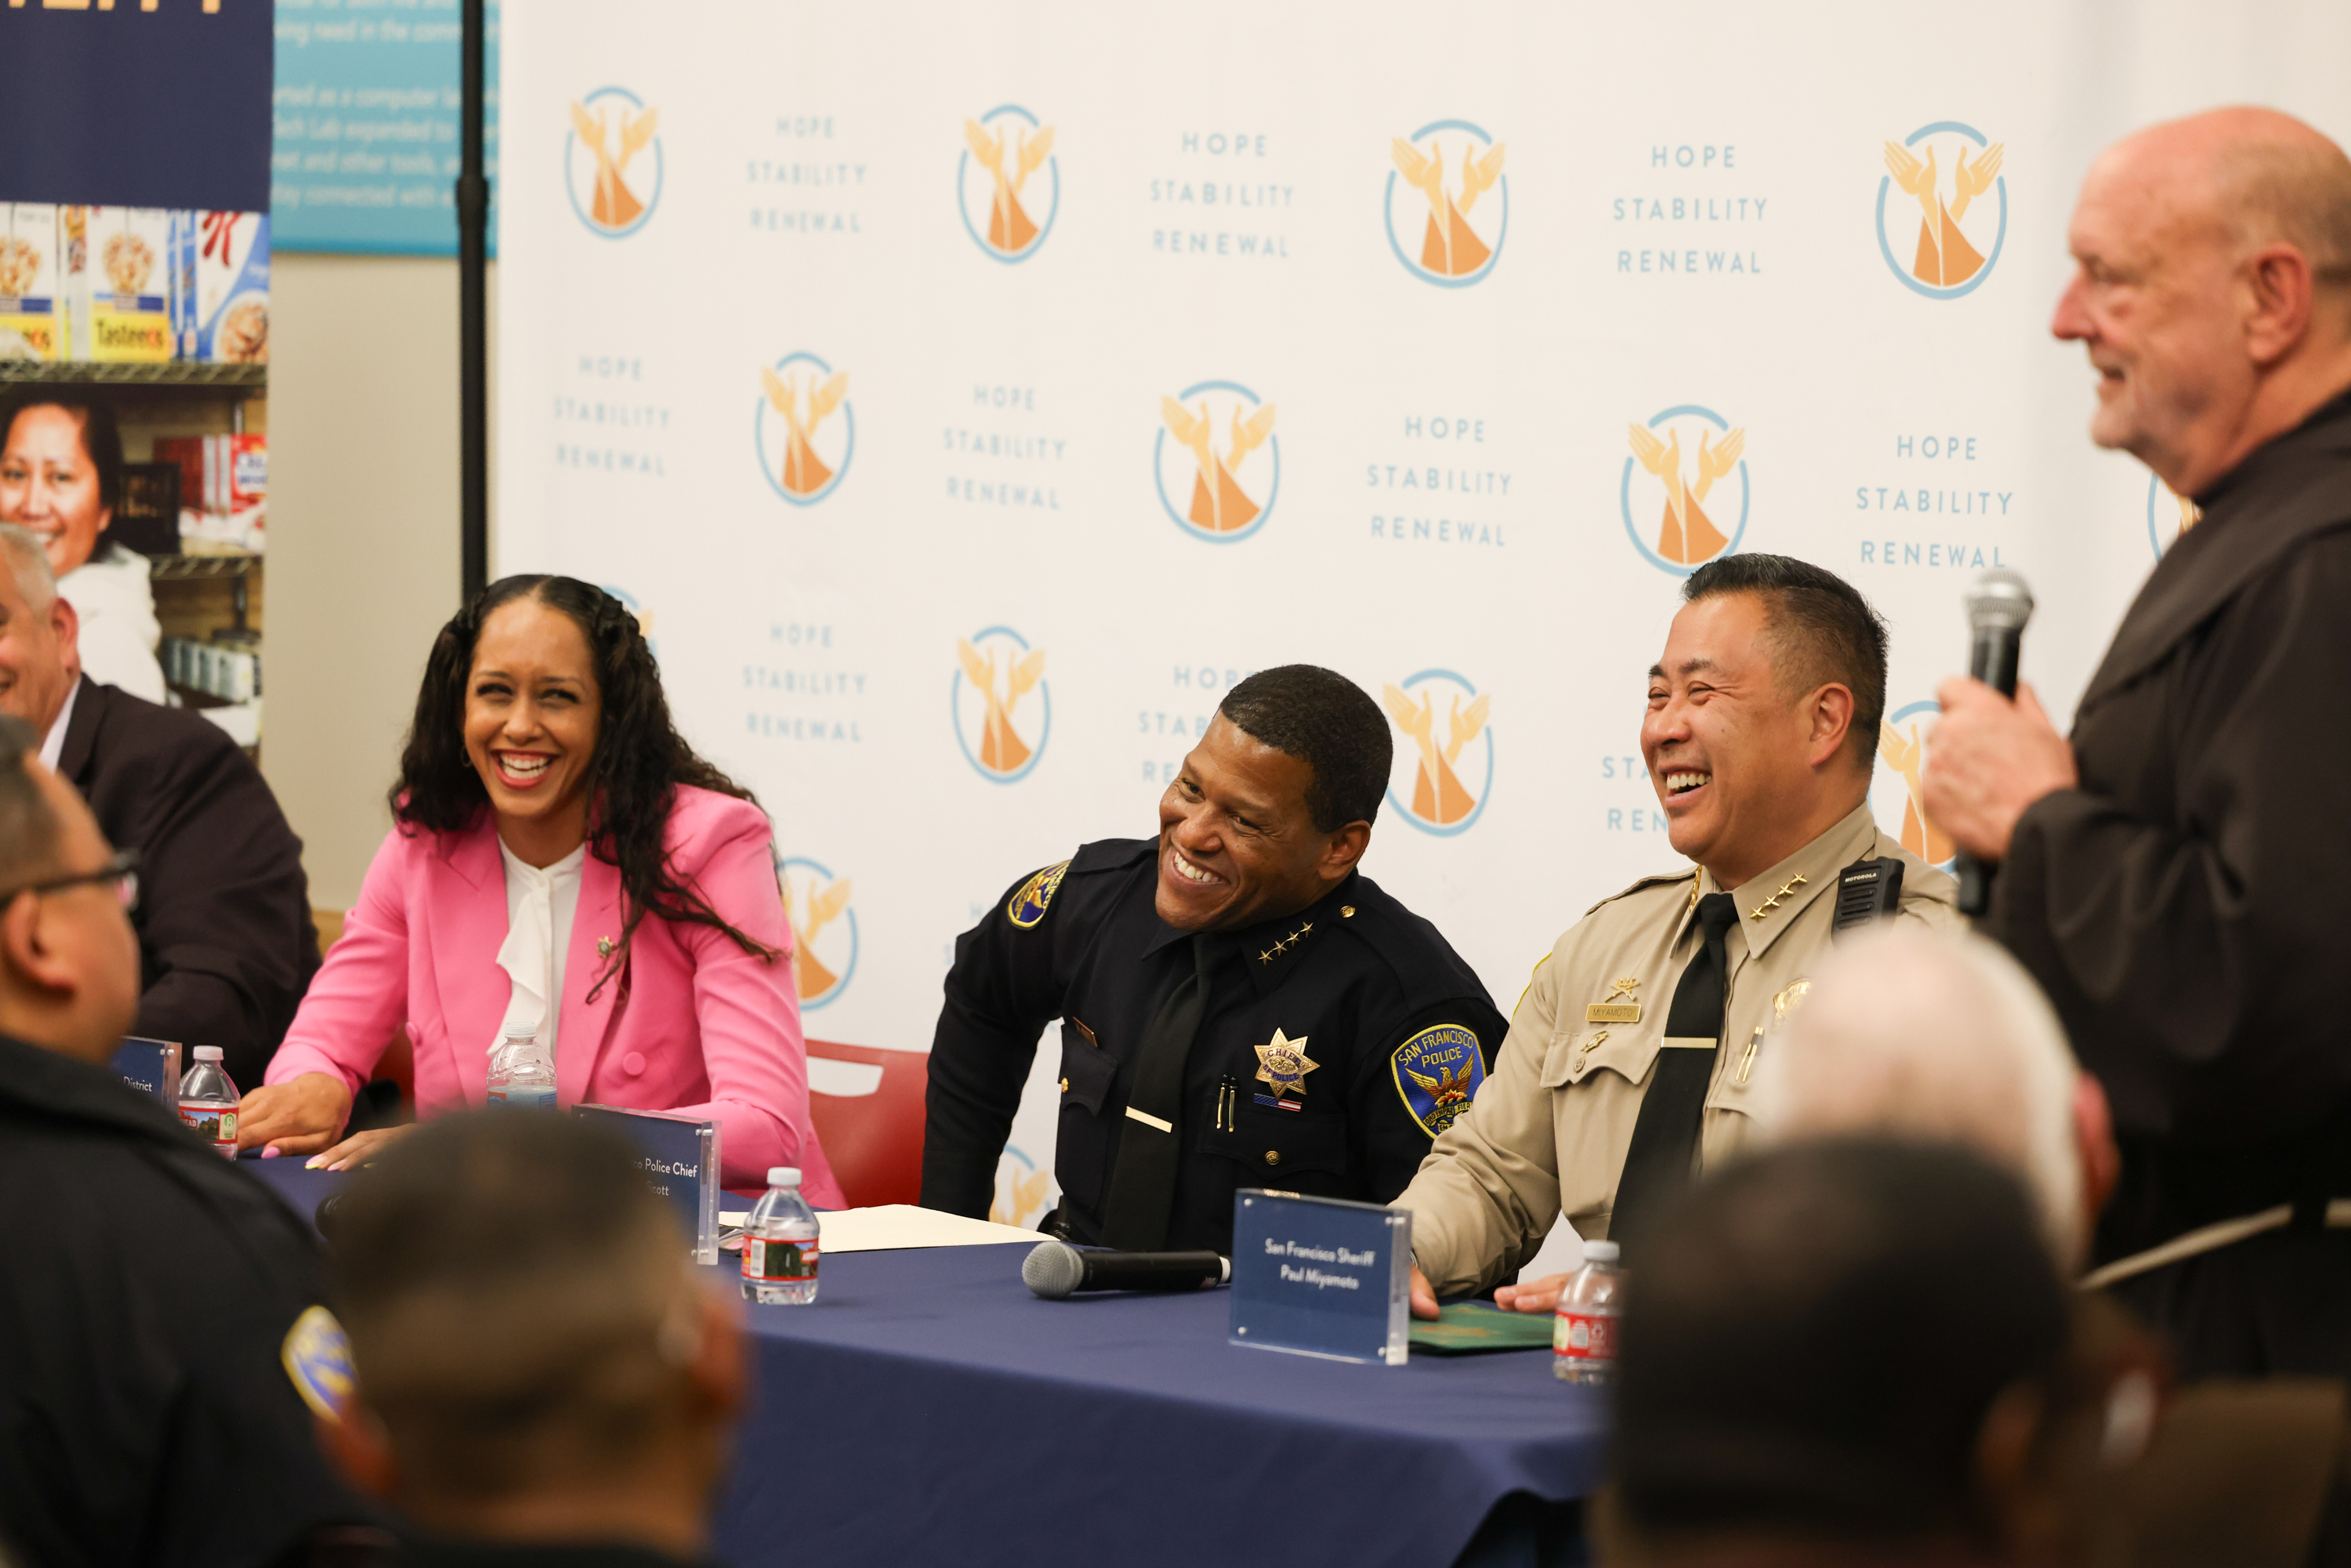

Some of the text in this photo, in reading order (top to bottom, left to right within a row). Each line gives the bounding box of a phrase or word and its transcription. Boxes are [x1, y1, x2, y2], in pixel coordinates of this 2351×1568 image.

[777, 116, 834, 139] HOPE
[1182, 132, 1266, 158] HOPE
[1652, 145, 1735, 168] HOPE
[747, 160, 867, 186] STABILITY
[1150, 179, 1294, 207] STABILITY
[750, 208, 860, 234] RENEWAL
[1614, 197, 1768, 222] STABILITY
[1153, 230, 1289, 258] RENEWAL
[1617, 250, 1762, 274] RENEWAL
[579, 355, 642, 381] HOPE
[973, 385, 1035, 411] HOPE
[552, 396, 671, 428] STABILITY
[1404, 416, 1484, 443] HOPE
[943, 427, 1067, 460] STABILITY
[1897, 436, 1977, 461] HOPE
[556, 443, 665, 476] RENEWAL
[1367, 464, 1512, 495] STABILITY
[946, 476, 1060, 510] RENEWAL
[1857, 487, 2013, 515] STABILITY
[1371, 515, 1505, 547] RENEWAL
[1860, 541, 2005, 569] RENEWAL
[770, 623, 833, 649] HOPE
[741, 664, 868, 695] STABILITY
[746, 712, 862, 744] RENEWAL
[1845, 872, 1877, 883] MOTOROLA
[1592, 1008, 1633, 1017] MIYAMOTO
[1267, 1048, 1302, 1065] CHIEF
[1398, 1030, 1474, 1066] SAN FRANCISCO
[1421, 1046, 1463, 1068] POLICE
[124, 1076, 152, 1092] District
[1272, 1071, 1299, 1082] POLICE
[645, 1158, 671, 1174] Police
[672, 1161, 698, 1177] Chief
[1265, 1237, 1376, 1267] San Francisco Sheriff
[1281, 1264, 1360, 1290] Paul Miyamoto
